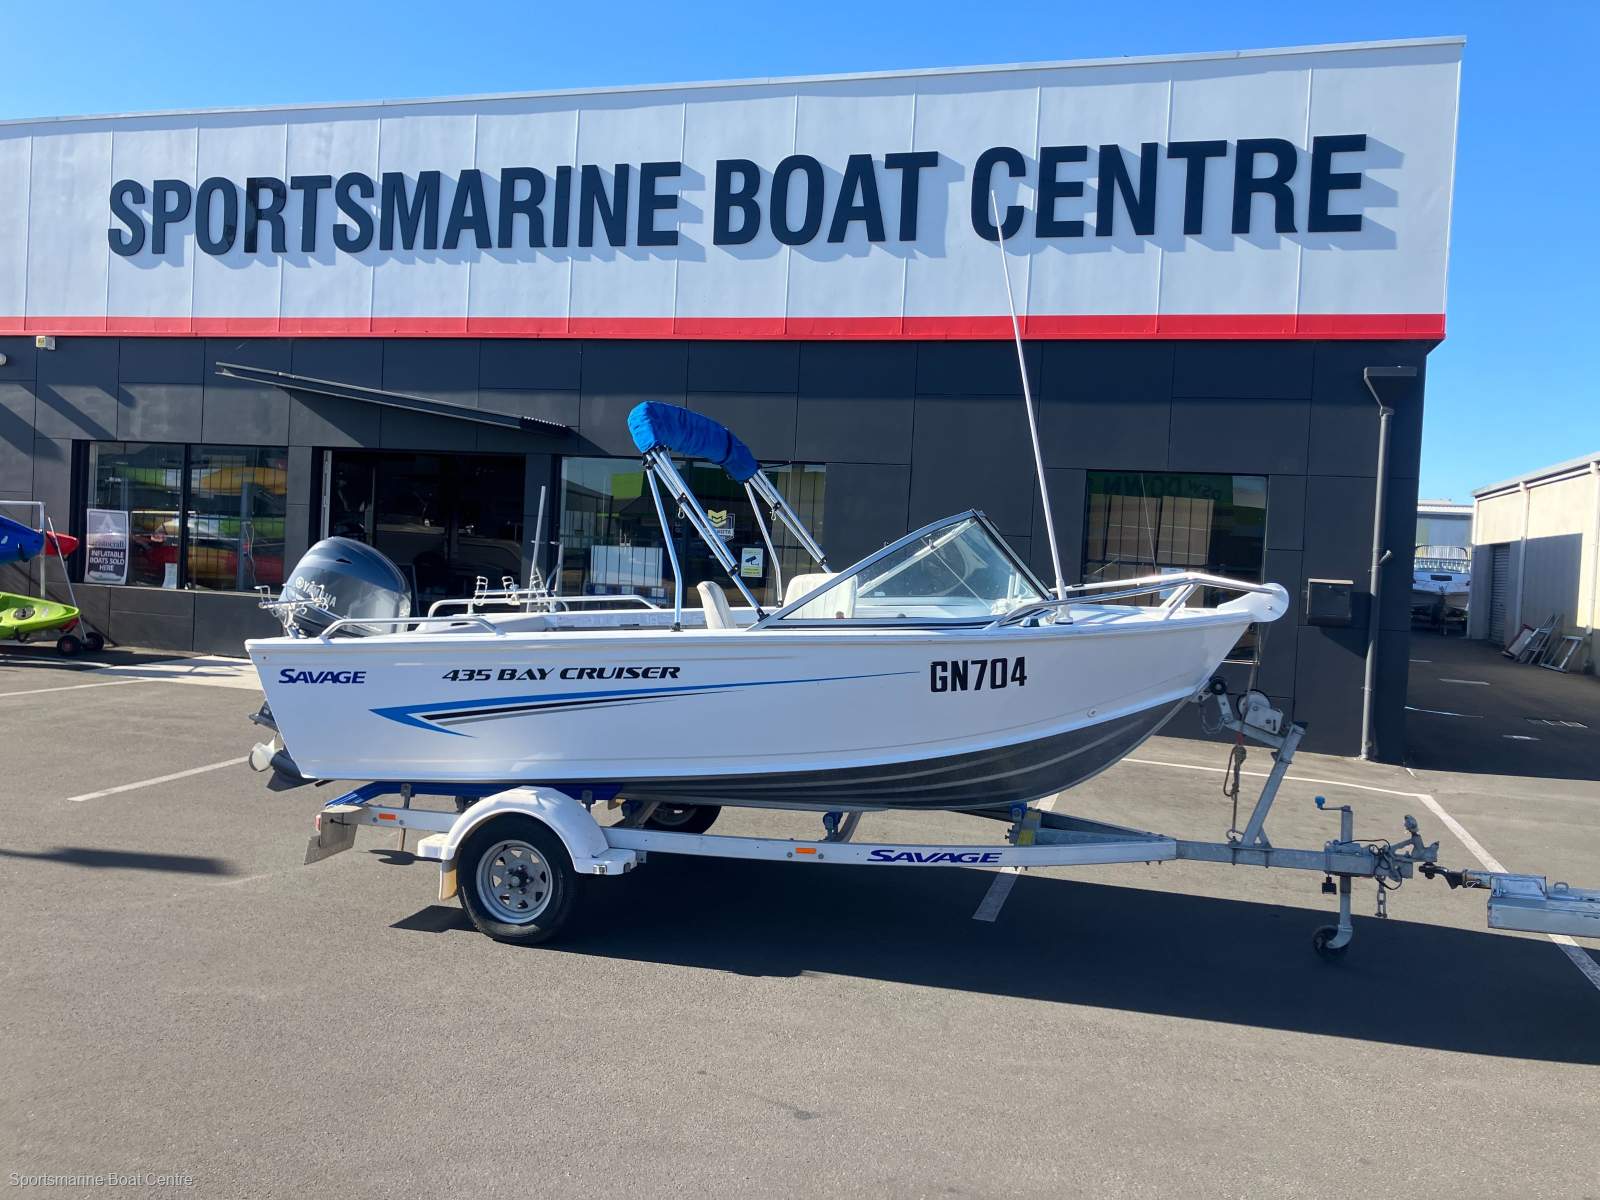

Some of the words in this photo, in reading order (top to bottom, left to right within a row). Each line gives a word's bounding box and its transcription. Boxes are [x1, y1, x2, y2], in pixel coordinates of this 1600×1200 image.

[107, 161, 682, 257] SPORTSMARINE
[713, 151, 939, 245] BOAT
[970, 134, 1368, 241] CENTRE
[91, 550, 124, 558] INFLATABLE
[442, 669, 493, 682] 435
[497, 667, 555, 681] BAY
[559, 666, 681, 681] CRUISER
[930, 656, 1028, 693] GN704
[867, 849, 1003, 864] SAVAGE
